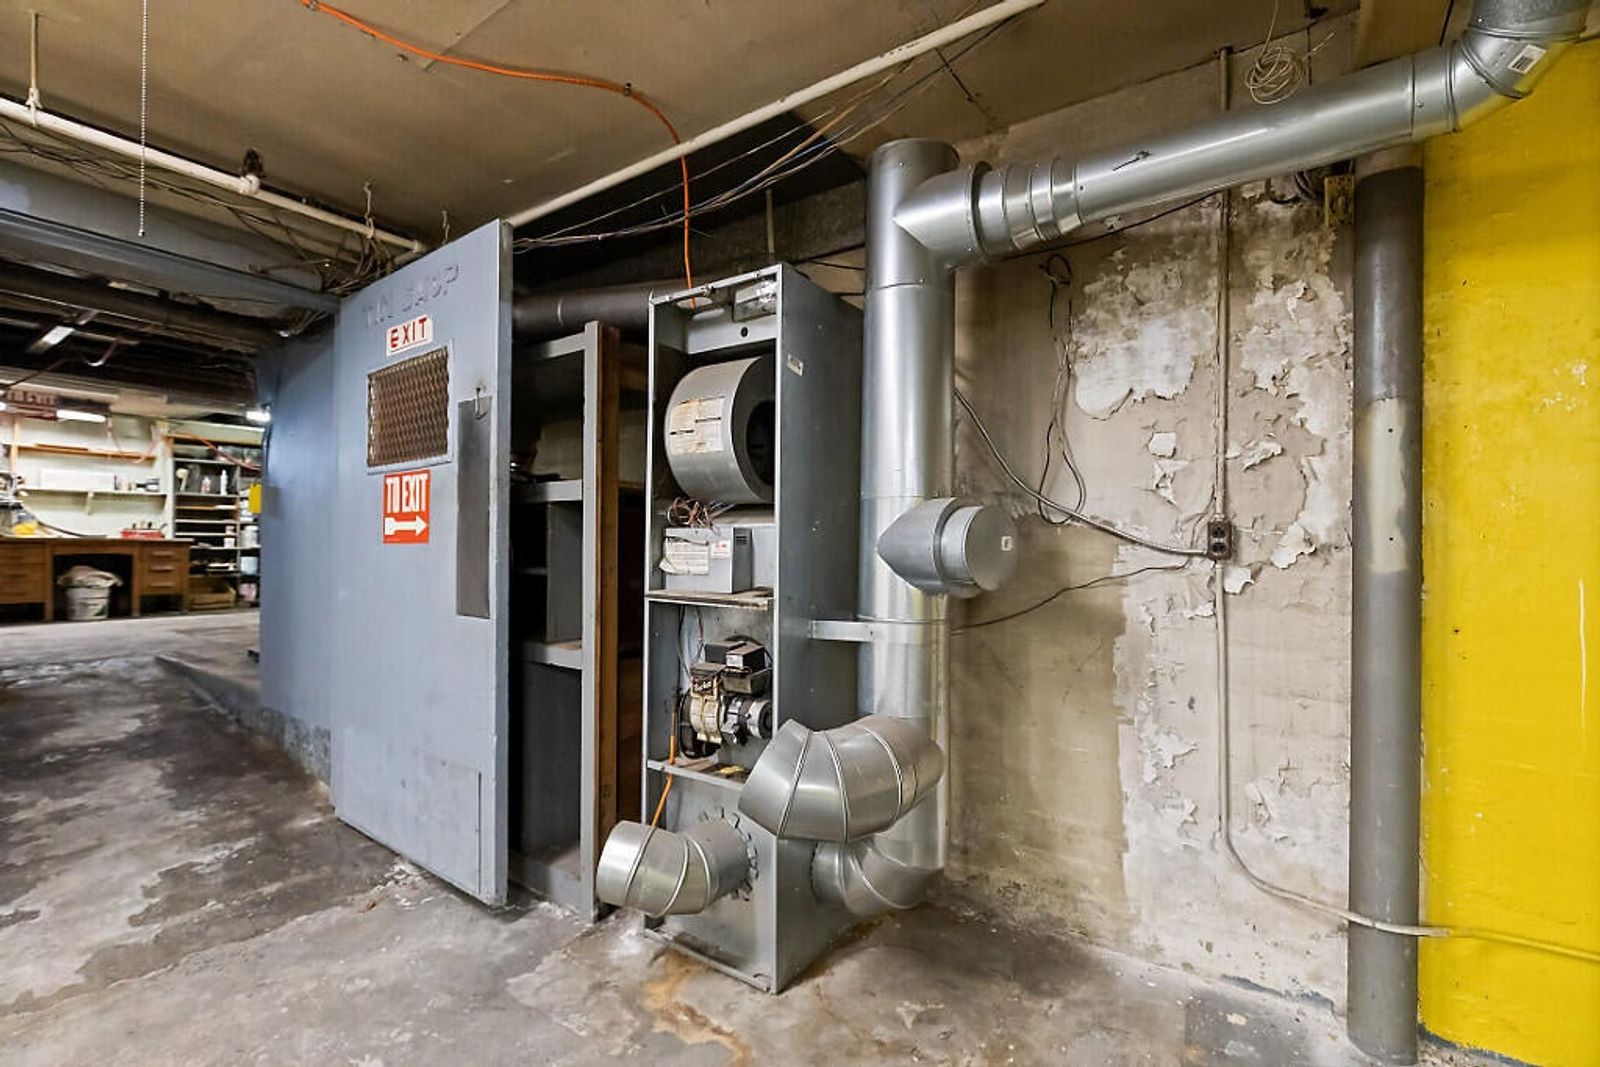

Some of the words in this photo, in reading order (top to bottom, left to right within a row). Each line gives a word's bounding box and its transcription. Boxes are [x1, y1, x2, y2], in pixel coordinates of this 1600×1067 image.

[390, 316, 428, 348] EXIT
[386, 477, 400, 514] TO
[401, 473, 428, 513] EXIT
